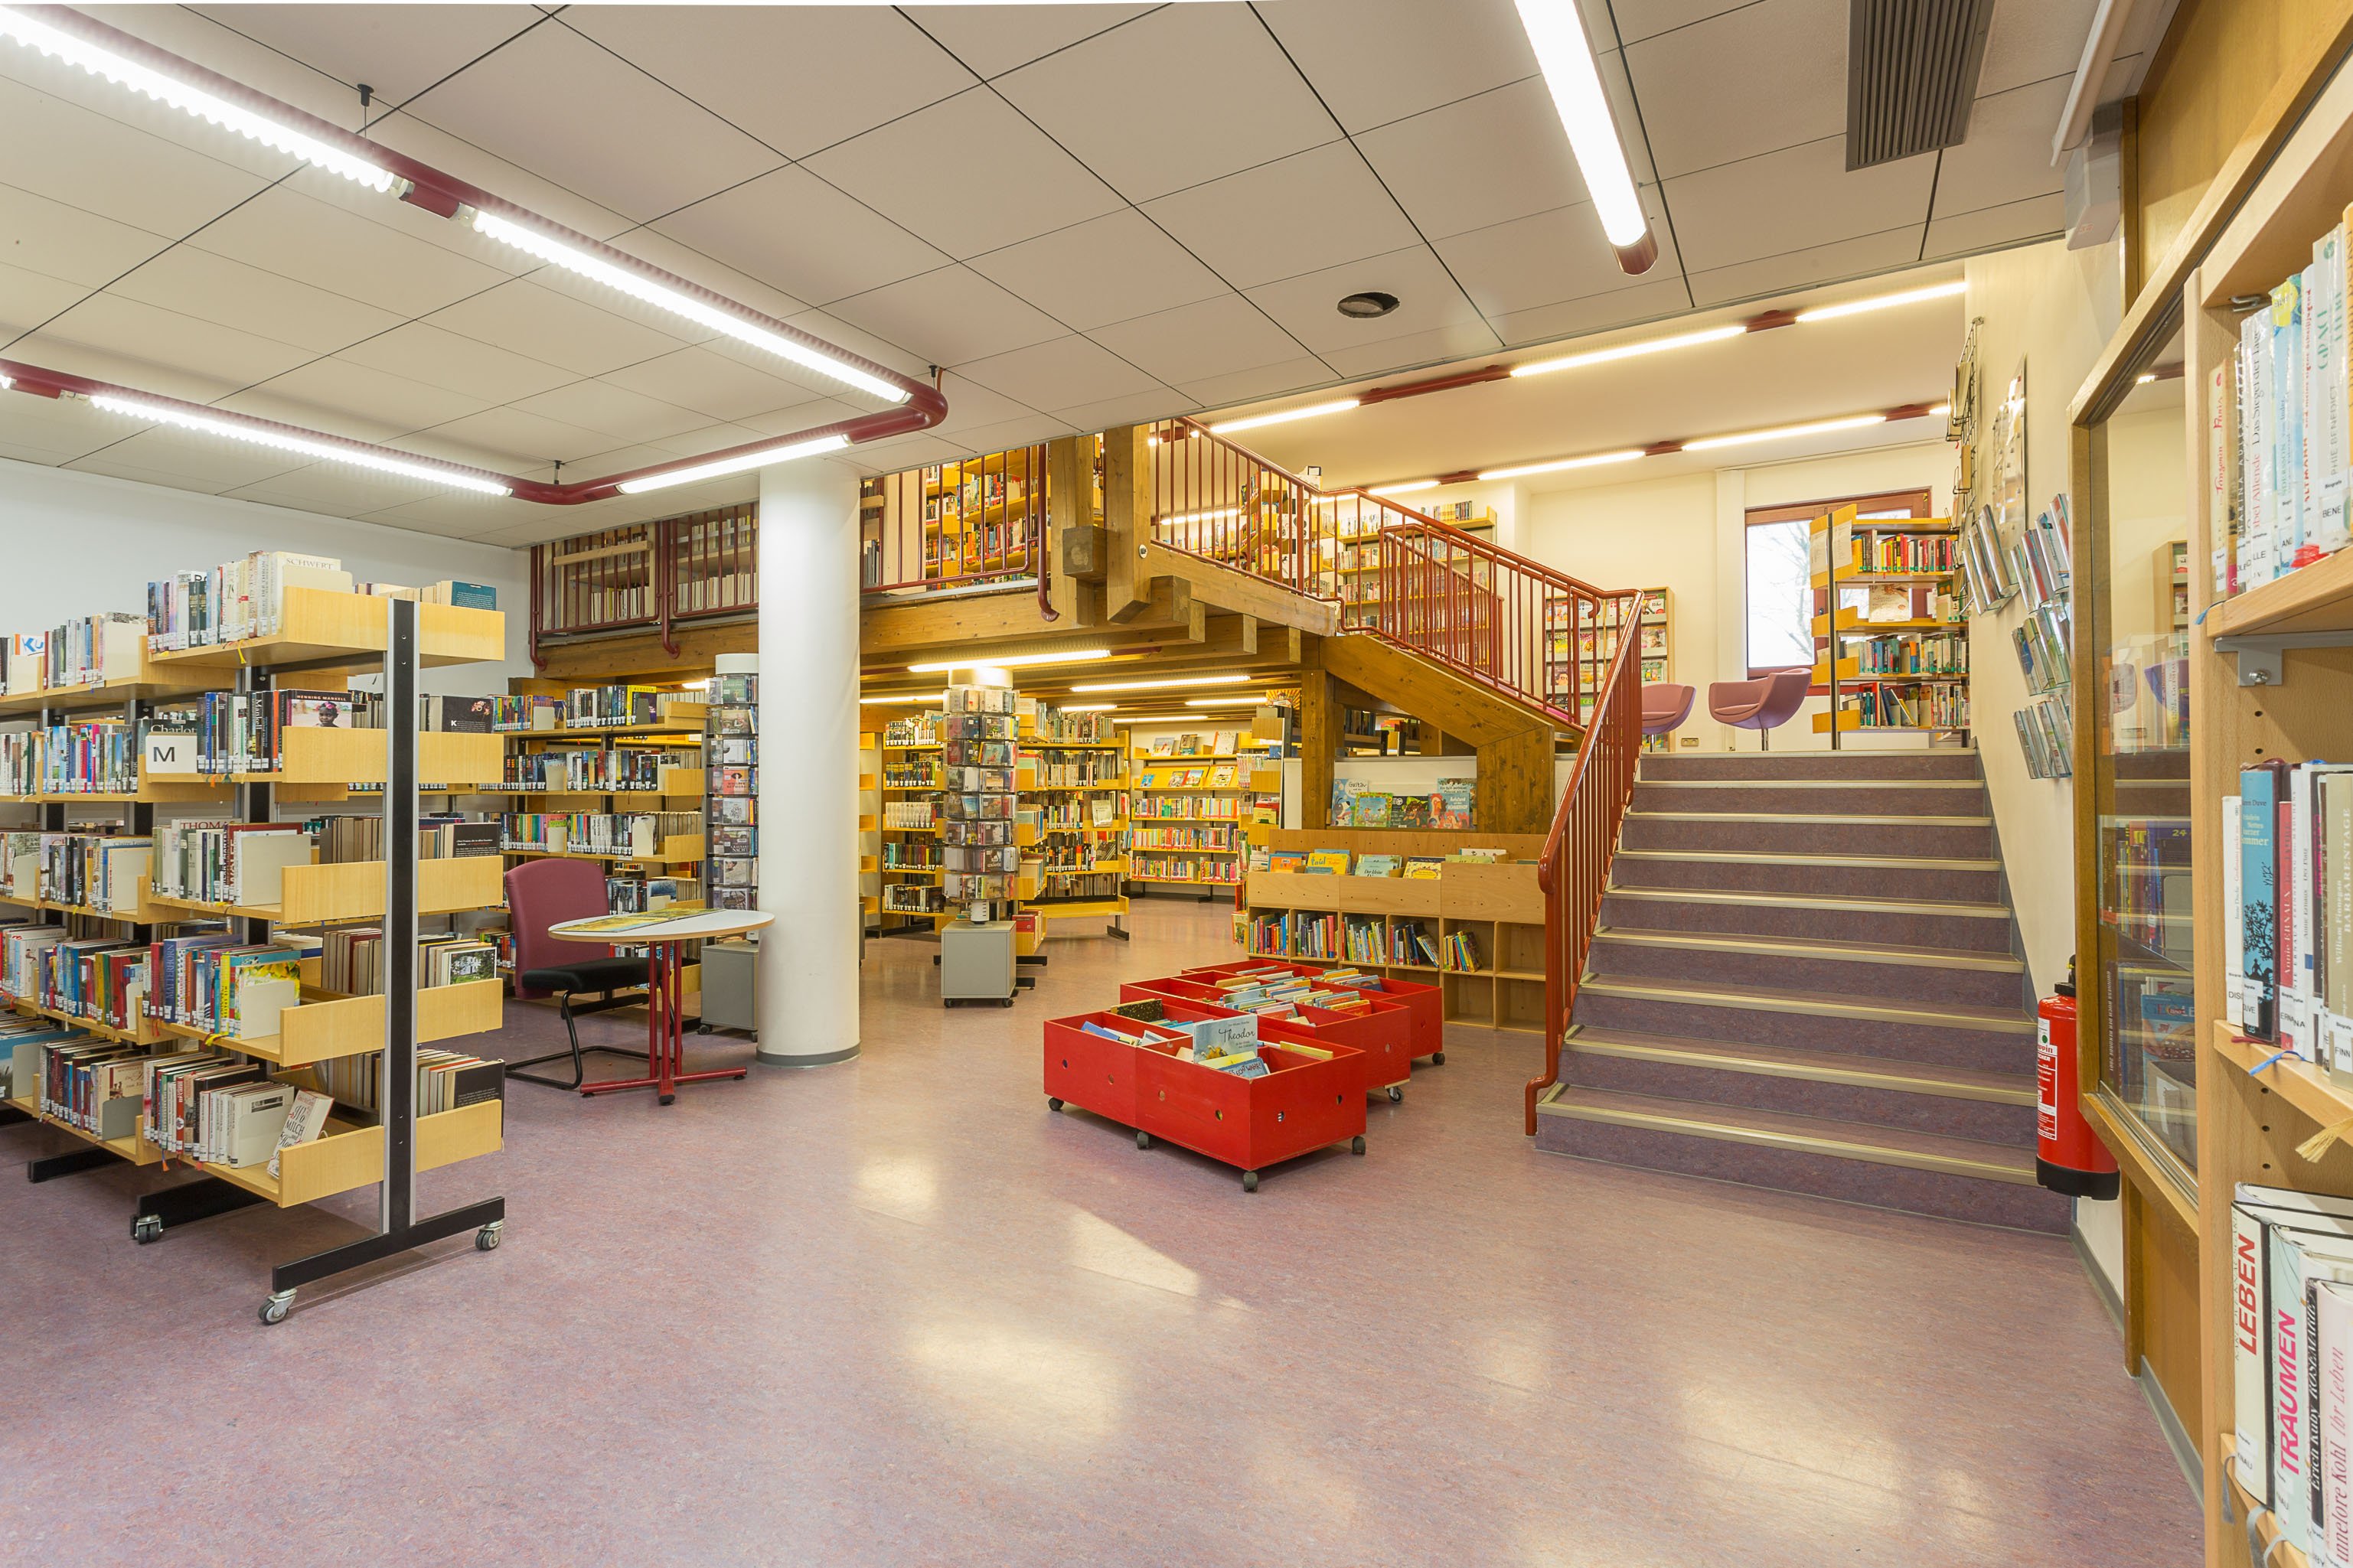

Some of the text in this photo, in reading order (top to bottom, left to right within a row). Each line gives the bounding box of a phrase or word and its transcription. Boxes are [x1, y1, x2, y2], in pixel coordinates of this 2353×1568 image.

[2253, 382, 2264, 419] Siegel
[2251, 454, 2260, 502] Allende
[2322, 505, 2342, 518] BENE
[286, 557, 335, 569] SCHWERT
[2253, 551, 2267, 560] LLE
[151, 724, 197, 733] Charlot
[153, 746, 175, 762] M
[2172, 829, 2187, 837] 24
[2242, 836, 2269, 846] ommer
[2342, 808, 2351, 933] BARBARENTAGE
[2335, 881, 2343, 924] Finnegan
[165, 944, 175, 999] MATTERHORN
[1218, 1028, 1256, 1042] Theodor
[2335, 1045, 2351, 1058] FINN
[286, 1120, 305, 1136] MILCH
[2237, 1233, 2257, 1356] LEBEN
[2277, 1308, 2299, 1475] TRÄUMEN
[2328, 1346, 2345, 1404] Leben
[2306, 1304, 2320, 1491] Erich Kuby ROSEMARIE
[2329, 1404, 2346, 1437] Ihr
[2329, 1440, 2347, 1485] Kohl
